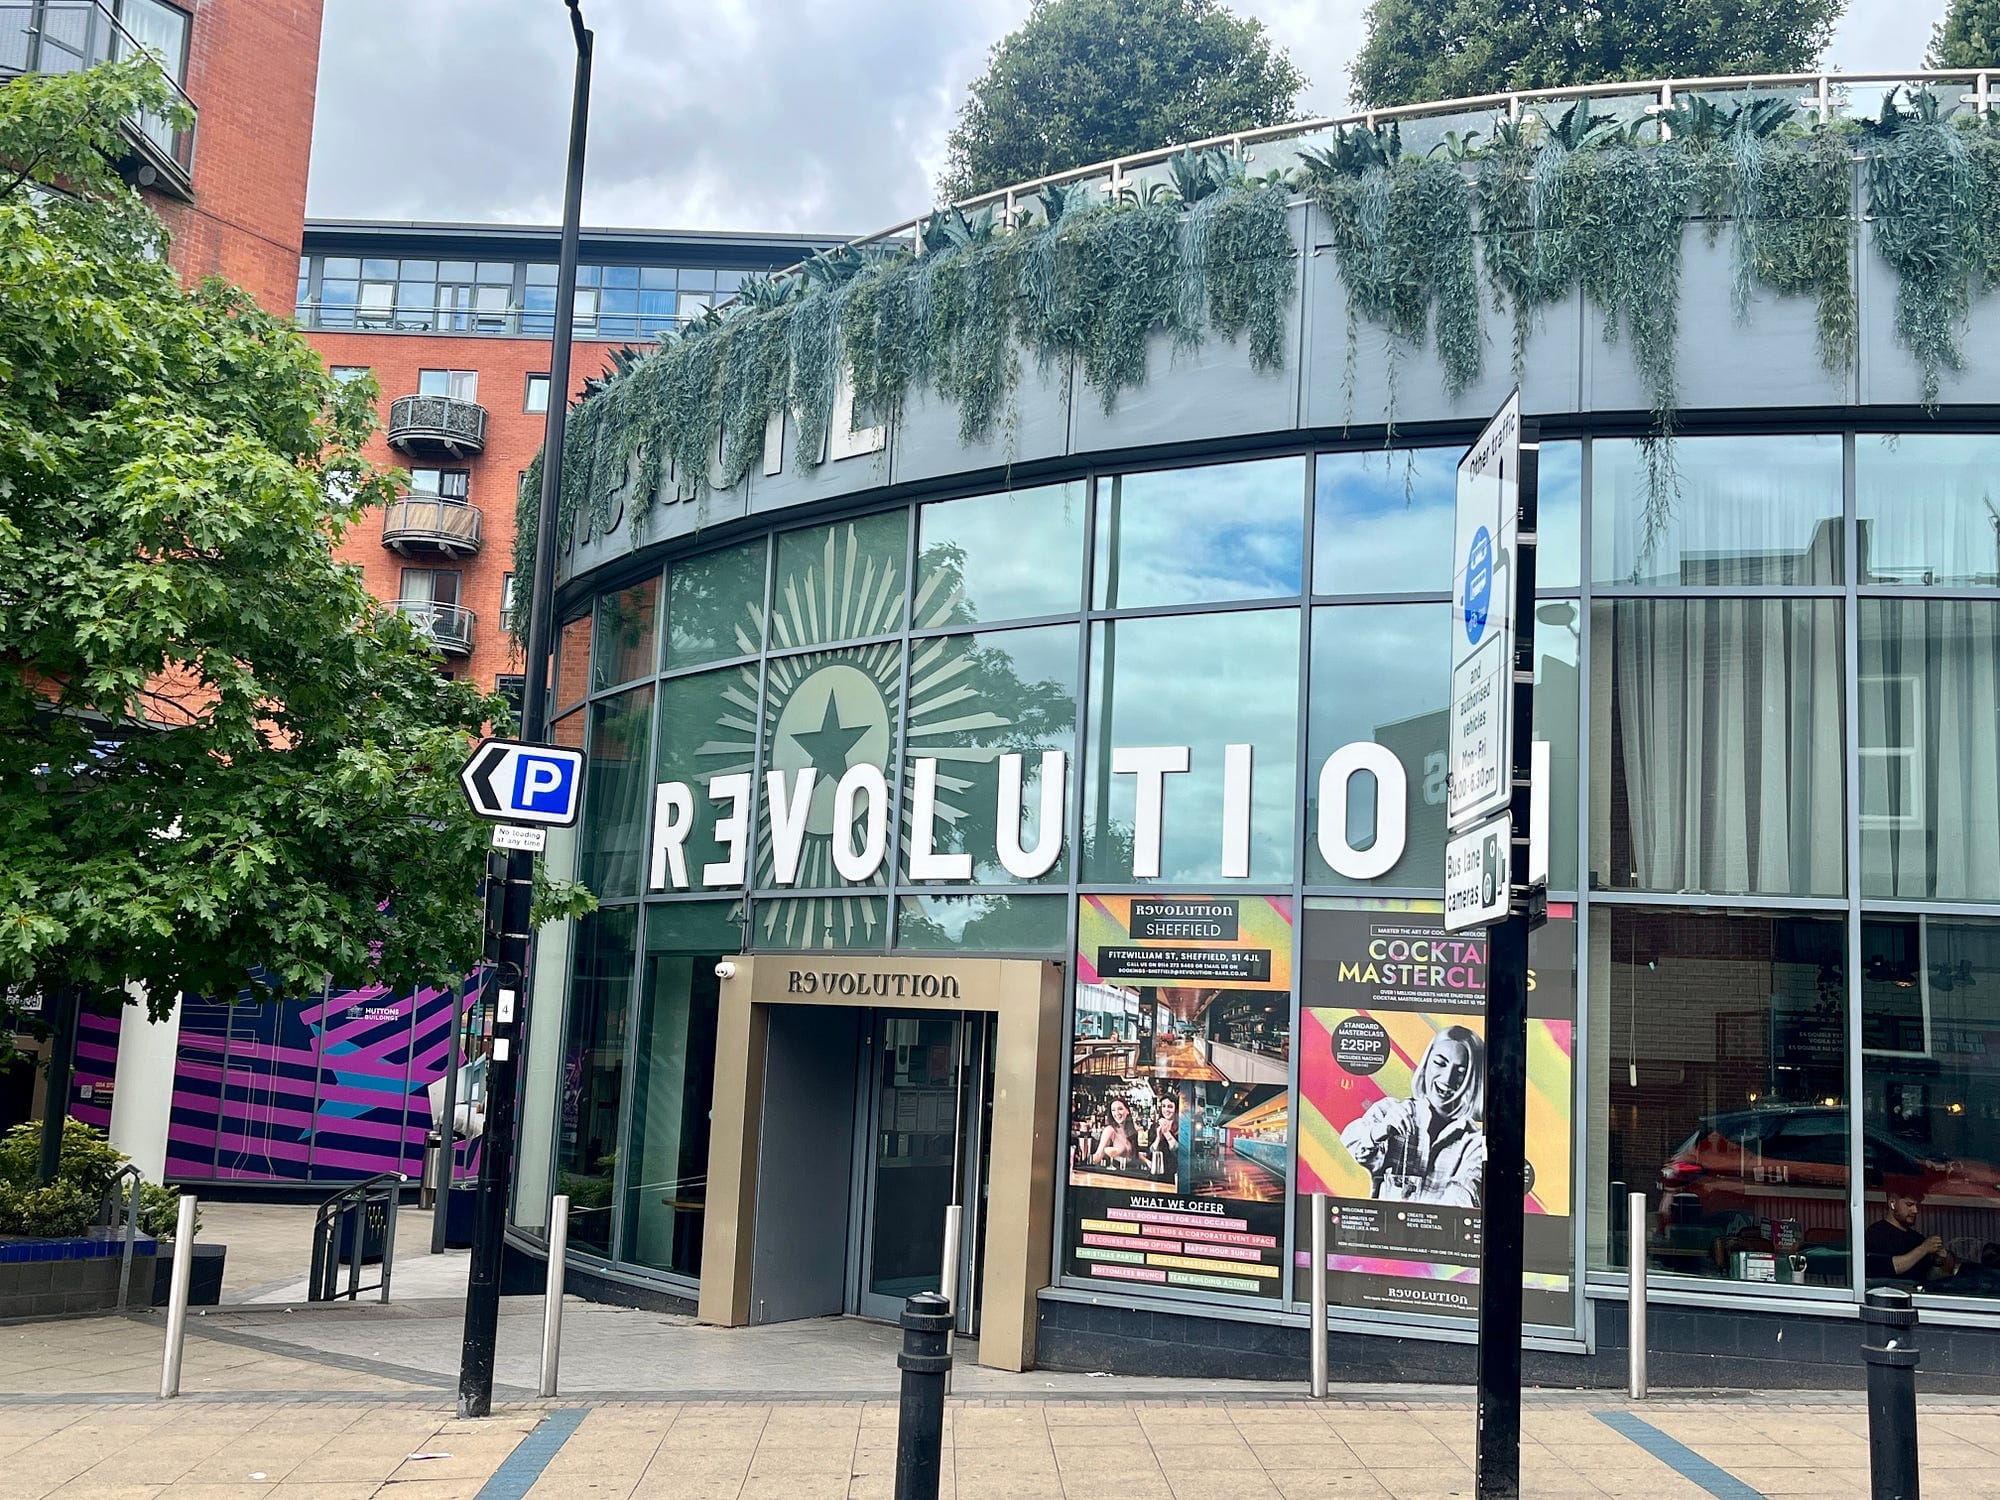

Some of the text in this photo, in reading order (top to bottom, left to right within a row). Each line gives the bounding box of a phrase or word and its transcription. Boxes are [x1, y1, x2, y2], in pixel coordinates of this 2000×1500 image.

[1469, 411, 1516, 483] Other traffic
[1470, 659, 1482, 684] and
[1460, 682, 1490, 716] authorised
[1463, 707, 1487, 738] vehicles
[1461, 745, 1474, 770] Mon
[1478, 737, 1488, 757] Fri
[521, 759, 562, 807] P
[499, 828, 541, 842] No loading
[507, 839, 521, 847] any
[524, 839, 541, 848] time
[1447, 847, 1480, 879] Bus lane
[1447, 883, 1479, 912] cameras
[1146, 923, 1221, 938] SHEFFIELD
[1108, 951, 1260, 962] FITZWILLIAM ST, SHEFFIELD, S1 4JL
[1369, 939, 1488, 964] COCKTAI
[1337, 960, 1537, 992] MASTERCLS
[365, 1007, 399, 1015] HUTTONS
[502, 1005, 509, 1014] 4
[1344, 1022, 1379, 1030] STANDARD
[1338, 1029, 1385, 1038] MASTERCLASS
[1340, 1038, 1382, 1052] £25PP
[1130, 1196, 1225, 1213] WHAT WE OFFER
[1204, 1218, 1246, 1228] OCCASIONS
[1143, 1225, 1176, 1235] MEETINGS
[1185, 1230, 1227, 1240] CORPORATE
[1252, 1237, 1275, 1245] SPACE
[1097, 1236, 1124, 1244] COURSE
[1125, 1238, 1149, 1246] DINING
[1151, 1241, 1180, 1250] OPTIONS
[1185, 1244, 1208, 1252] HAPPY
[1077, 1249, 1143, 1261] CHRISTMAS PARTIES
[1148, 1253, 1182, 1264] OCKTAIL
[1092, 1266, 1135, 1276] BOTTOMLESS
[1190, 1277, 1222, 1286] BUILDING
